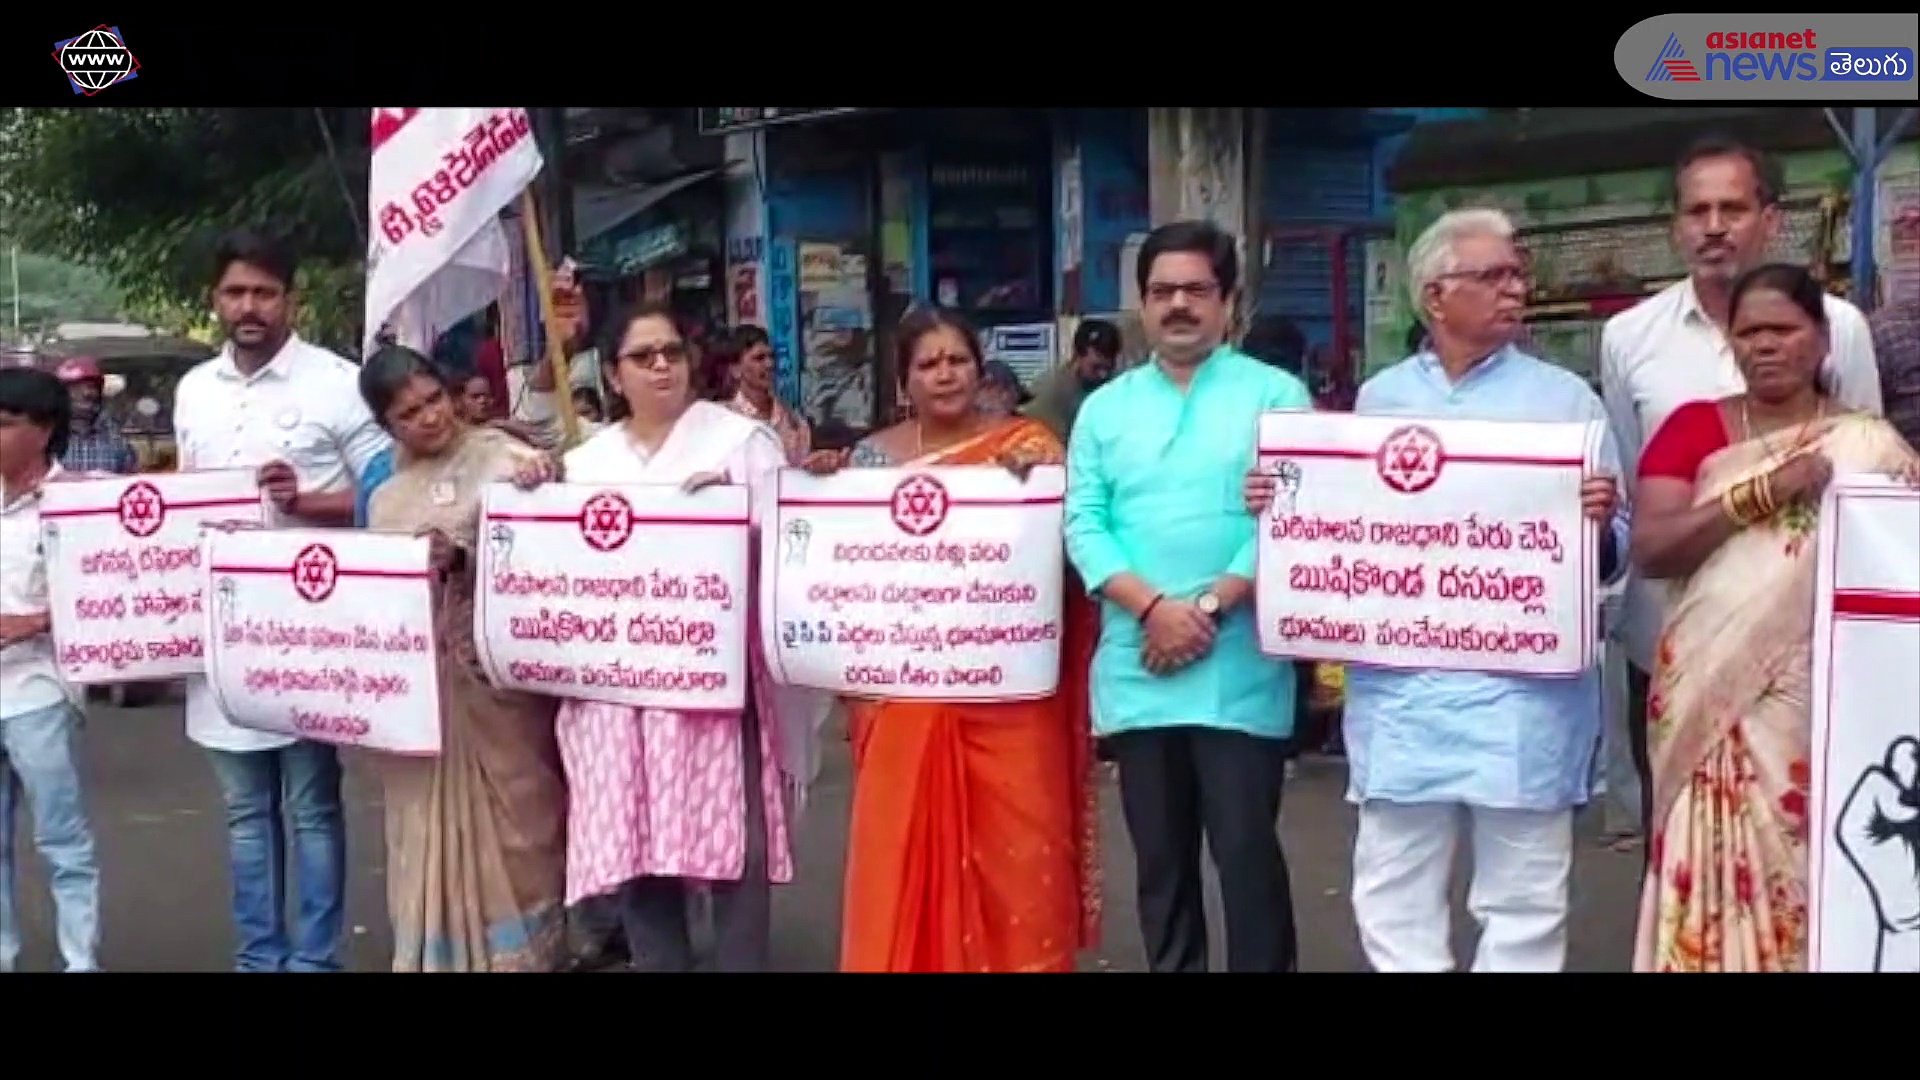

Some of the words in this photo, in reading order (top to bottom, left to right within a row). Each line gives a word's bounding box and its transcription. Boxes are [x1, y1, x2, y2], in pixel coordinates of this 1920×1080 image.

[1271, 515, 1364, 545] పరిపాలన
[1371, 520, 1458, 550] రాజధాని
[1464, 513, 1511, 549] పేరు
[1518, 520, 1563, 563] చెప్పి
[493, 570, 568, 597] పరిపాలన
[573, 574, 646, 600] రాజధాని
[650, 568, 688, 598] పేరు
[693, 572, 733, 611] చెప్పి
[1438, 565, 1546, 615] దసపల్లా
[627, 612, 717, 656] దసపల్లా
[1279, 616, 1366, 643] భూములు
[1377, 617, 1559, 654] పంచేసుకుంటారా
